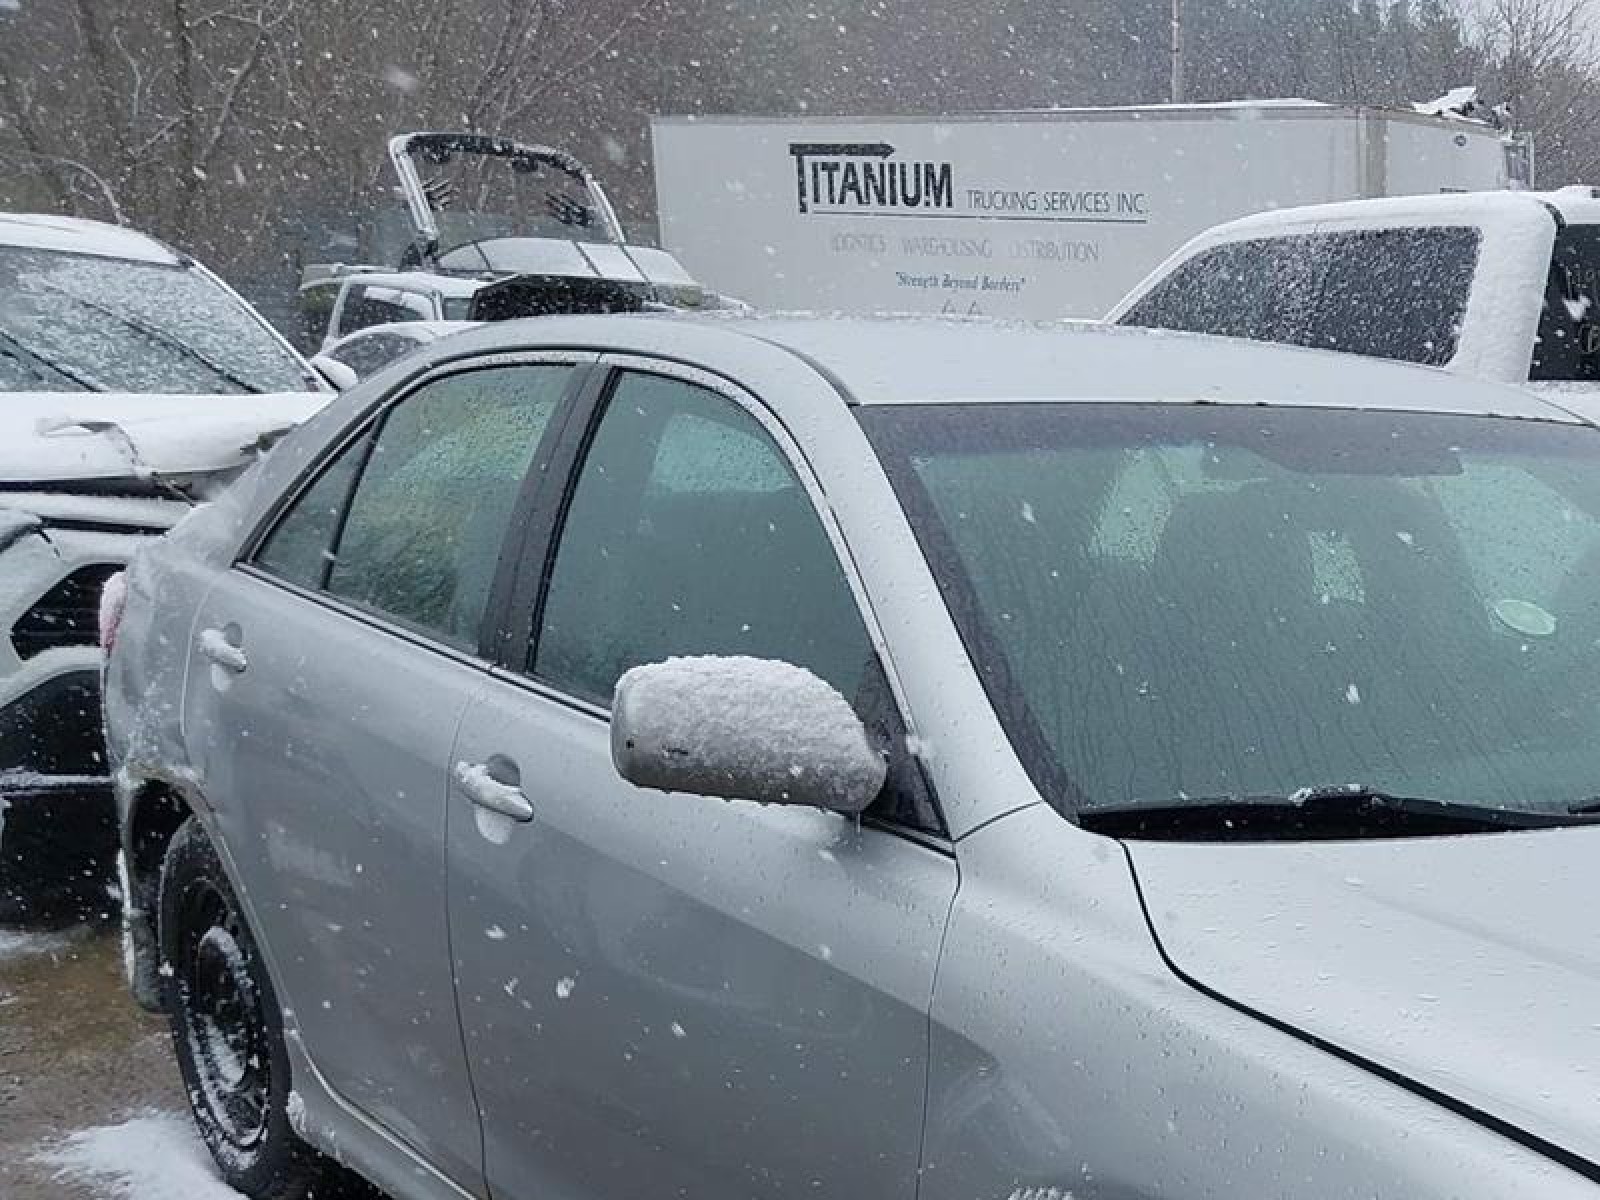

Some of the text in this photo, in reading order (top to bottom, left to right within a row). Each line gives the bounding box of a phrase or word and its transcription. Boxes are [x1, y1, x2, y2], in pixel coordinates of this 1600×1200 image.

[789, 143, 953, 213] TITANIUM
[966, 189, 1037, 211] TRUCKING
[1043, 191, 1110, 213] SERVICES
